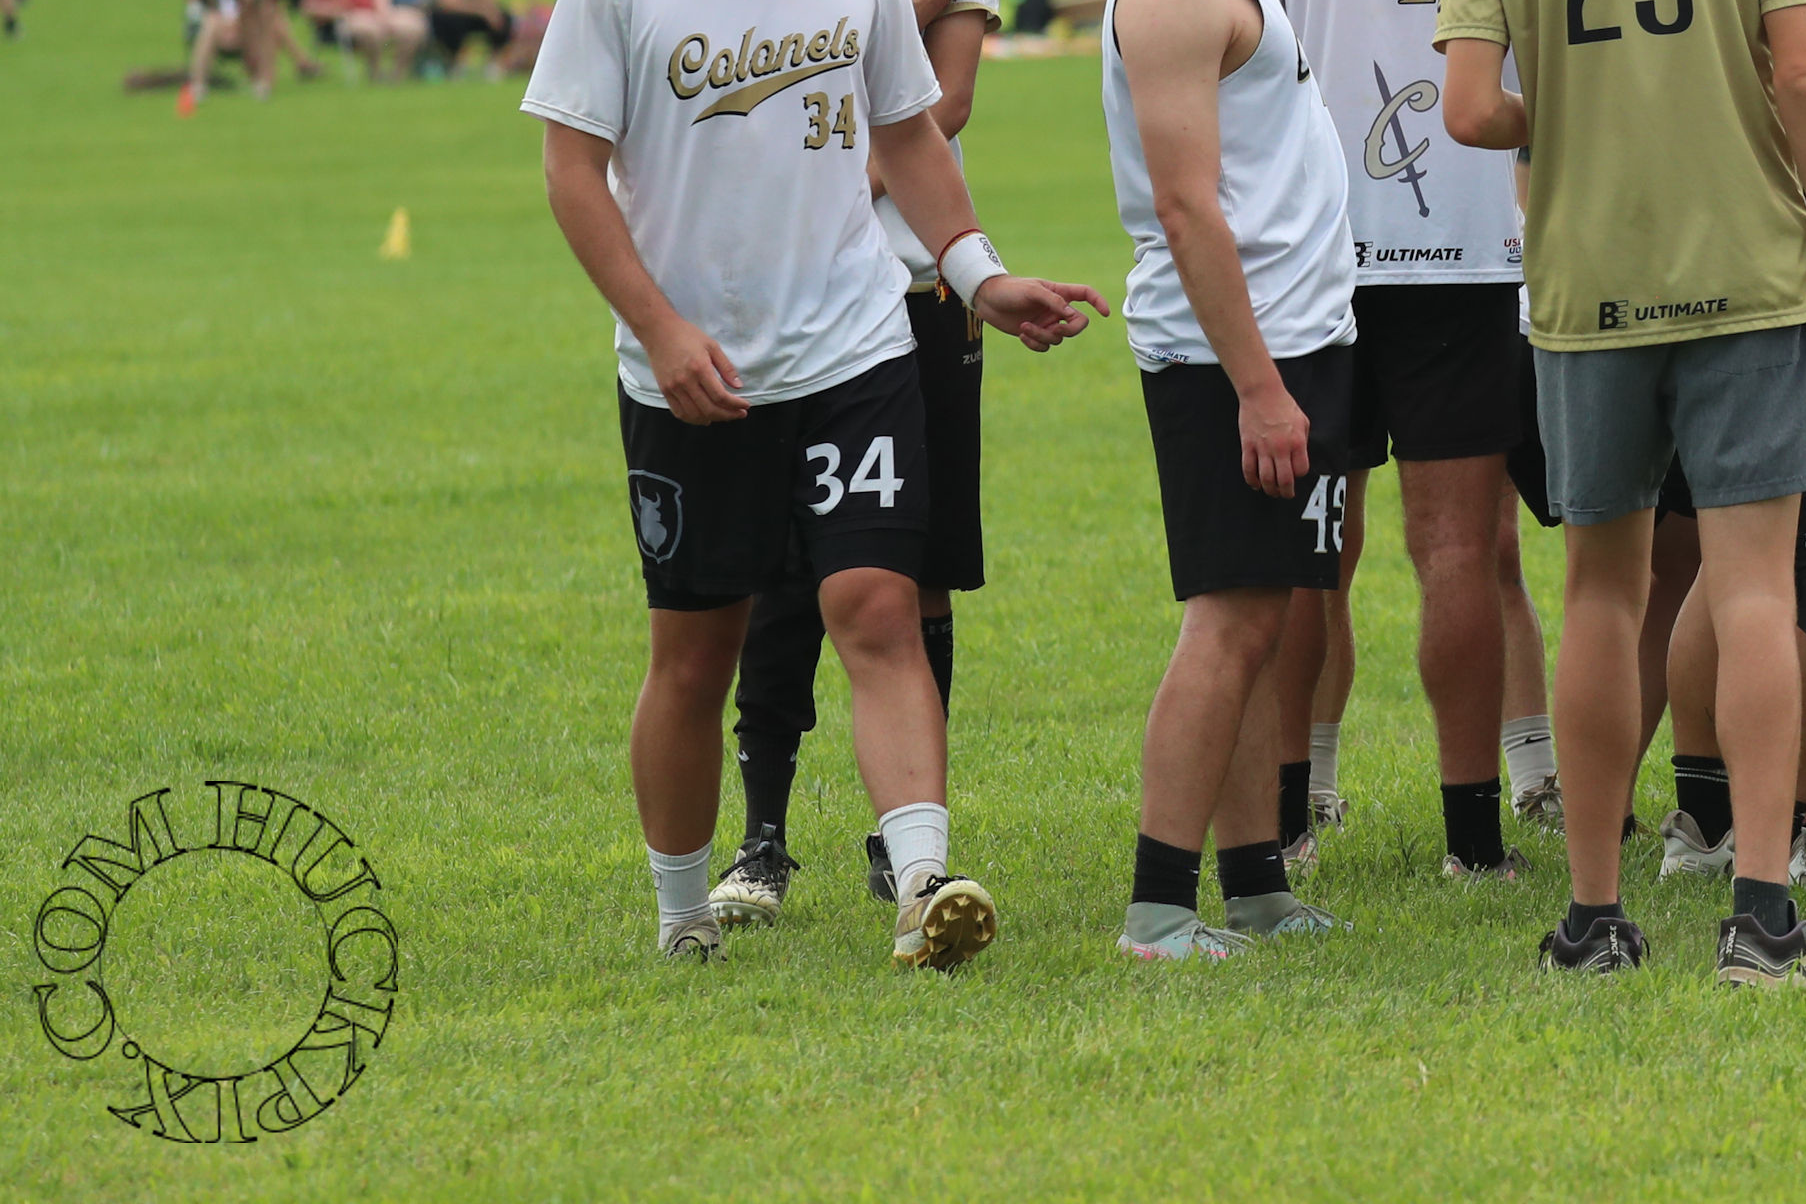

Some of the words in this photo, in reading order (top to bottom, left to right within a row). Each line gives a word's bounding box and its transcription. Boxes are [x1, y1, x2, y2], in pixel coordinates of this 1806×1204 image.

[666, 15, 860, 101] Colonels
[803, 90, 857, 150] 34
[1376, 247, 1463, 262] ULTIMATE
[1635, 298, 1728, 321] ULTIMATE
[806, 436, 905, 516] 34
